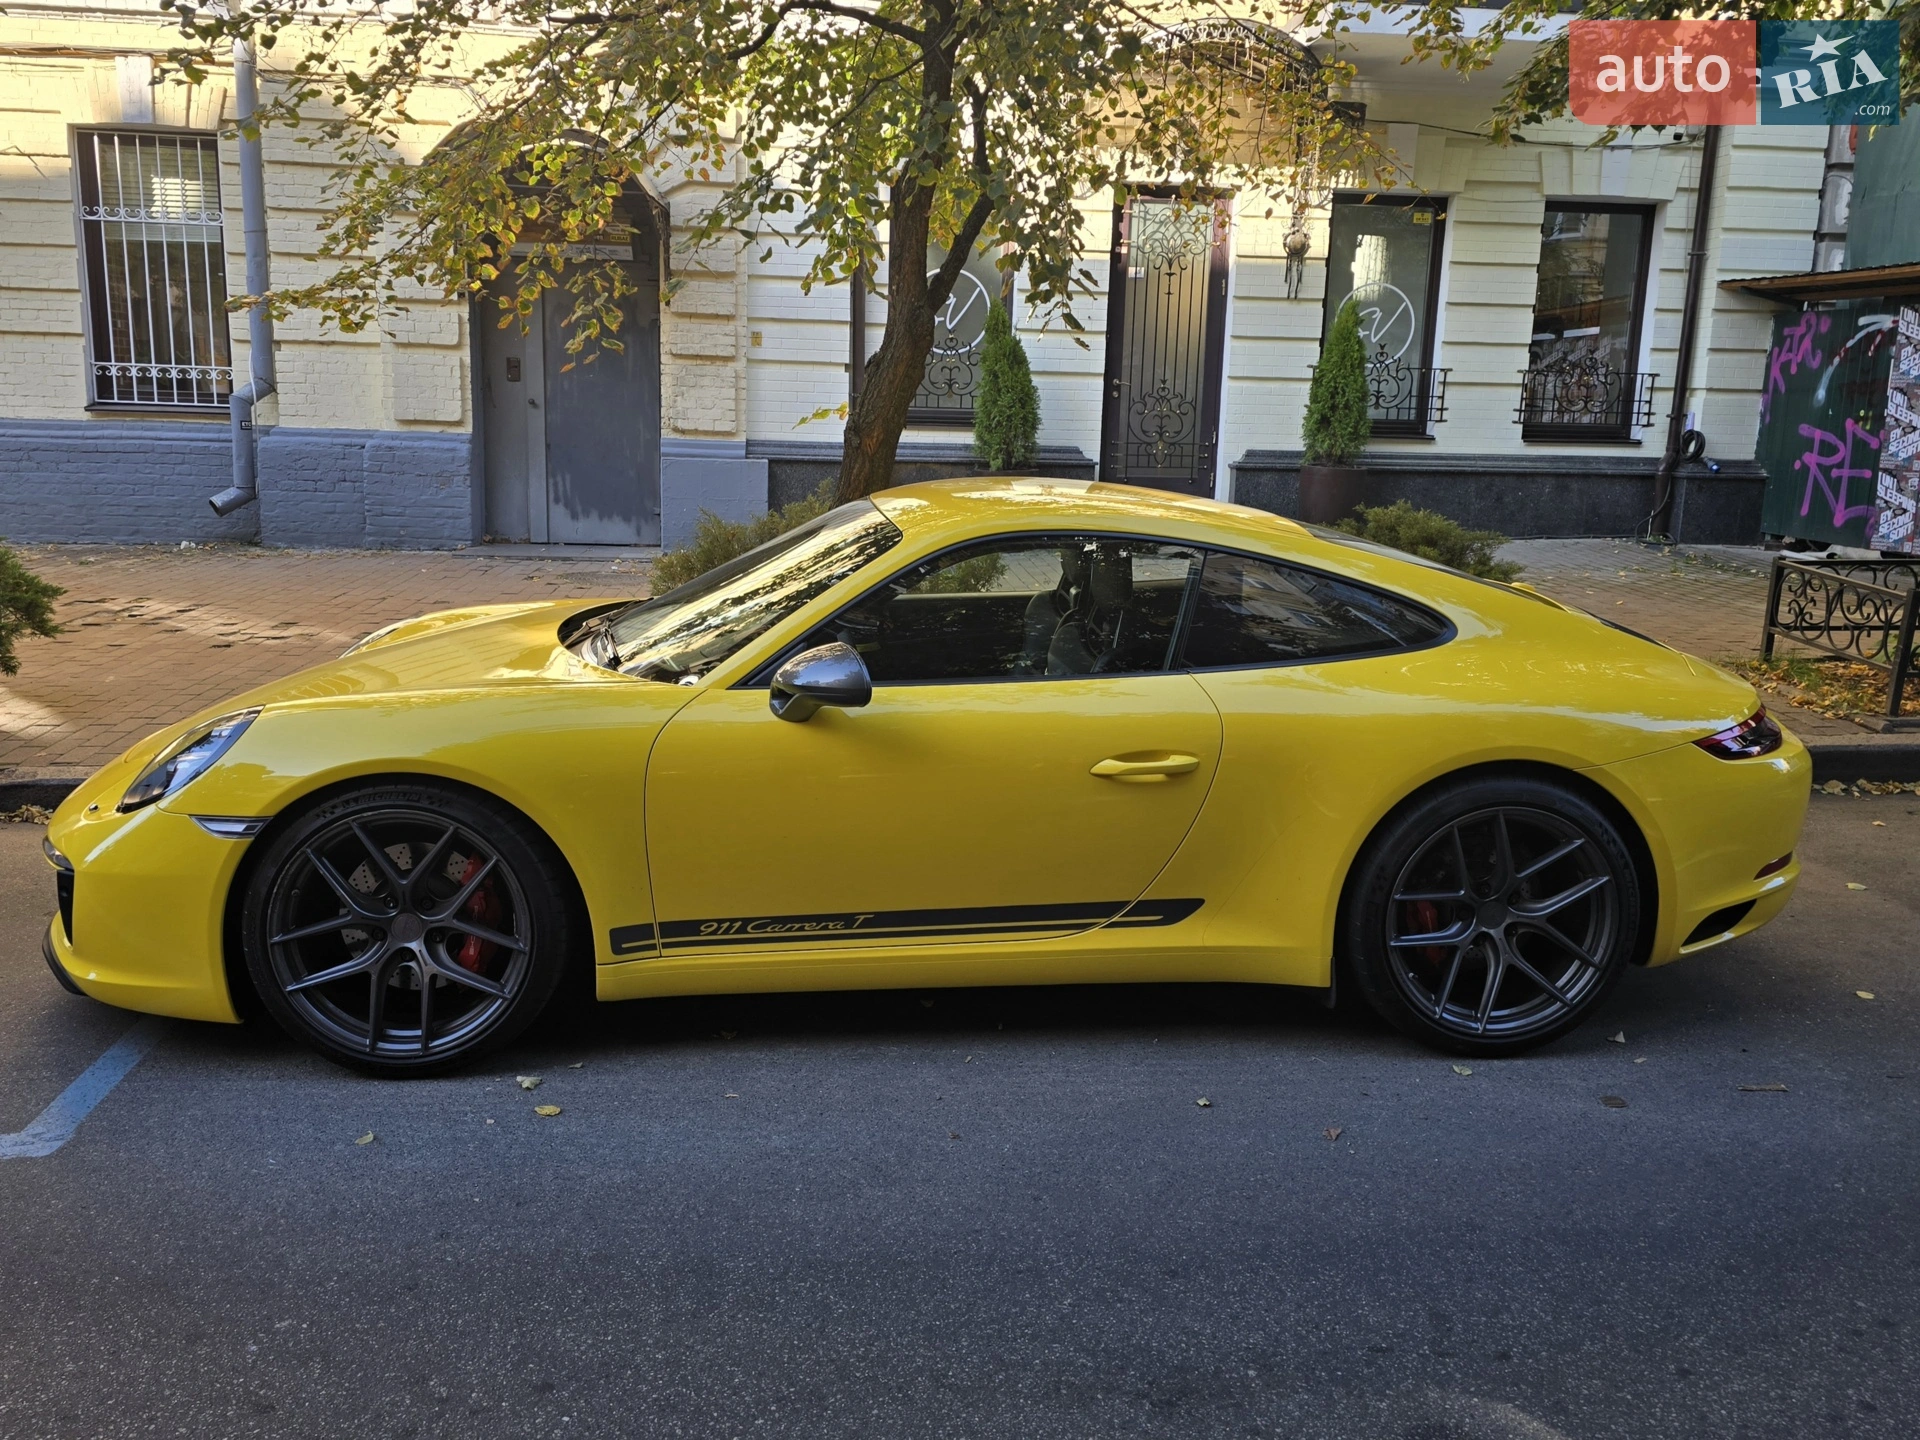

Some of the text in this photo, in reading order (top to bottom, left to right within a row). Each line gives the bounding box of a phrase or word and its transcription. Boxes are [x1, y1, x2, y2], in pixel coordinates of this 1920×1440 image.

[1877, 485, 1916, 514] SLEEPING
[1879, 512, 1913, 536] SECOND
[1880, 509, 1893, 525] BY
[700, 914, 875, 935] 911 Carrera T
